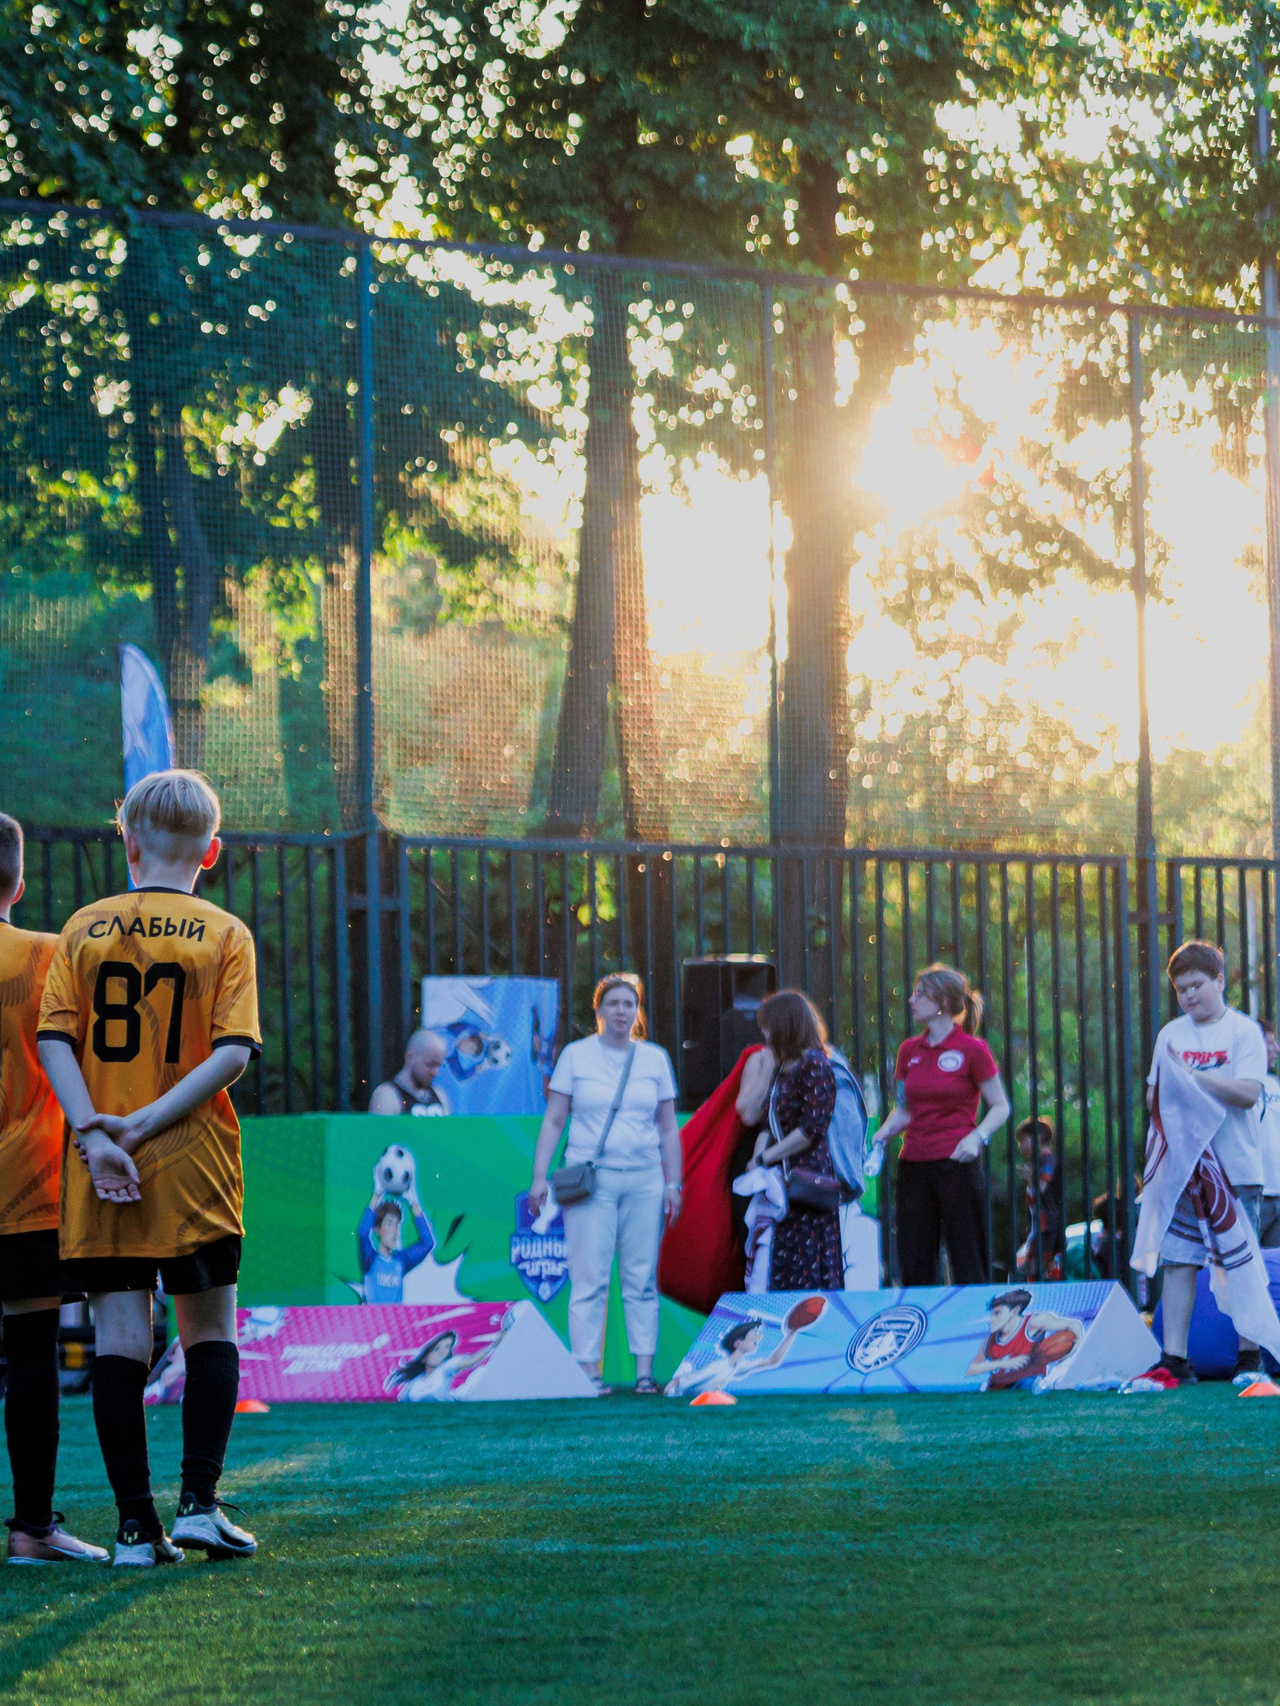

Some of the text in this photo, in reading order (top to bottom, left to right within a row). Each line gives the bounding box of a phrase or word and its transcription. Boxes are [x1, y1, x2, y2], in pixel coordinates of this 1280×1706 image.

[88, 917, 205, 942] СЛАБЫЙ
[92, 961, 187, 1063] 87
[511, 1236, 568, 1263] РОДНЫ
